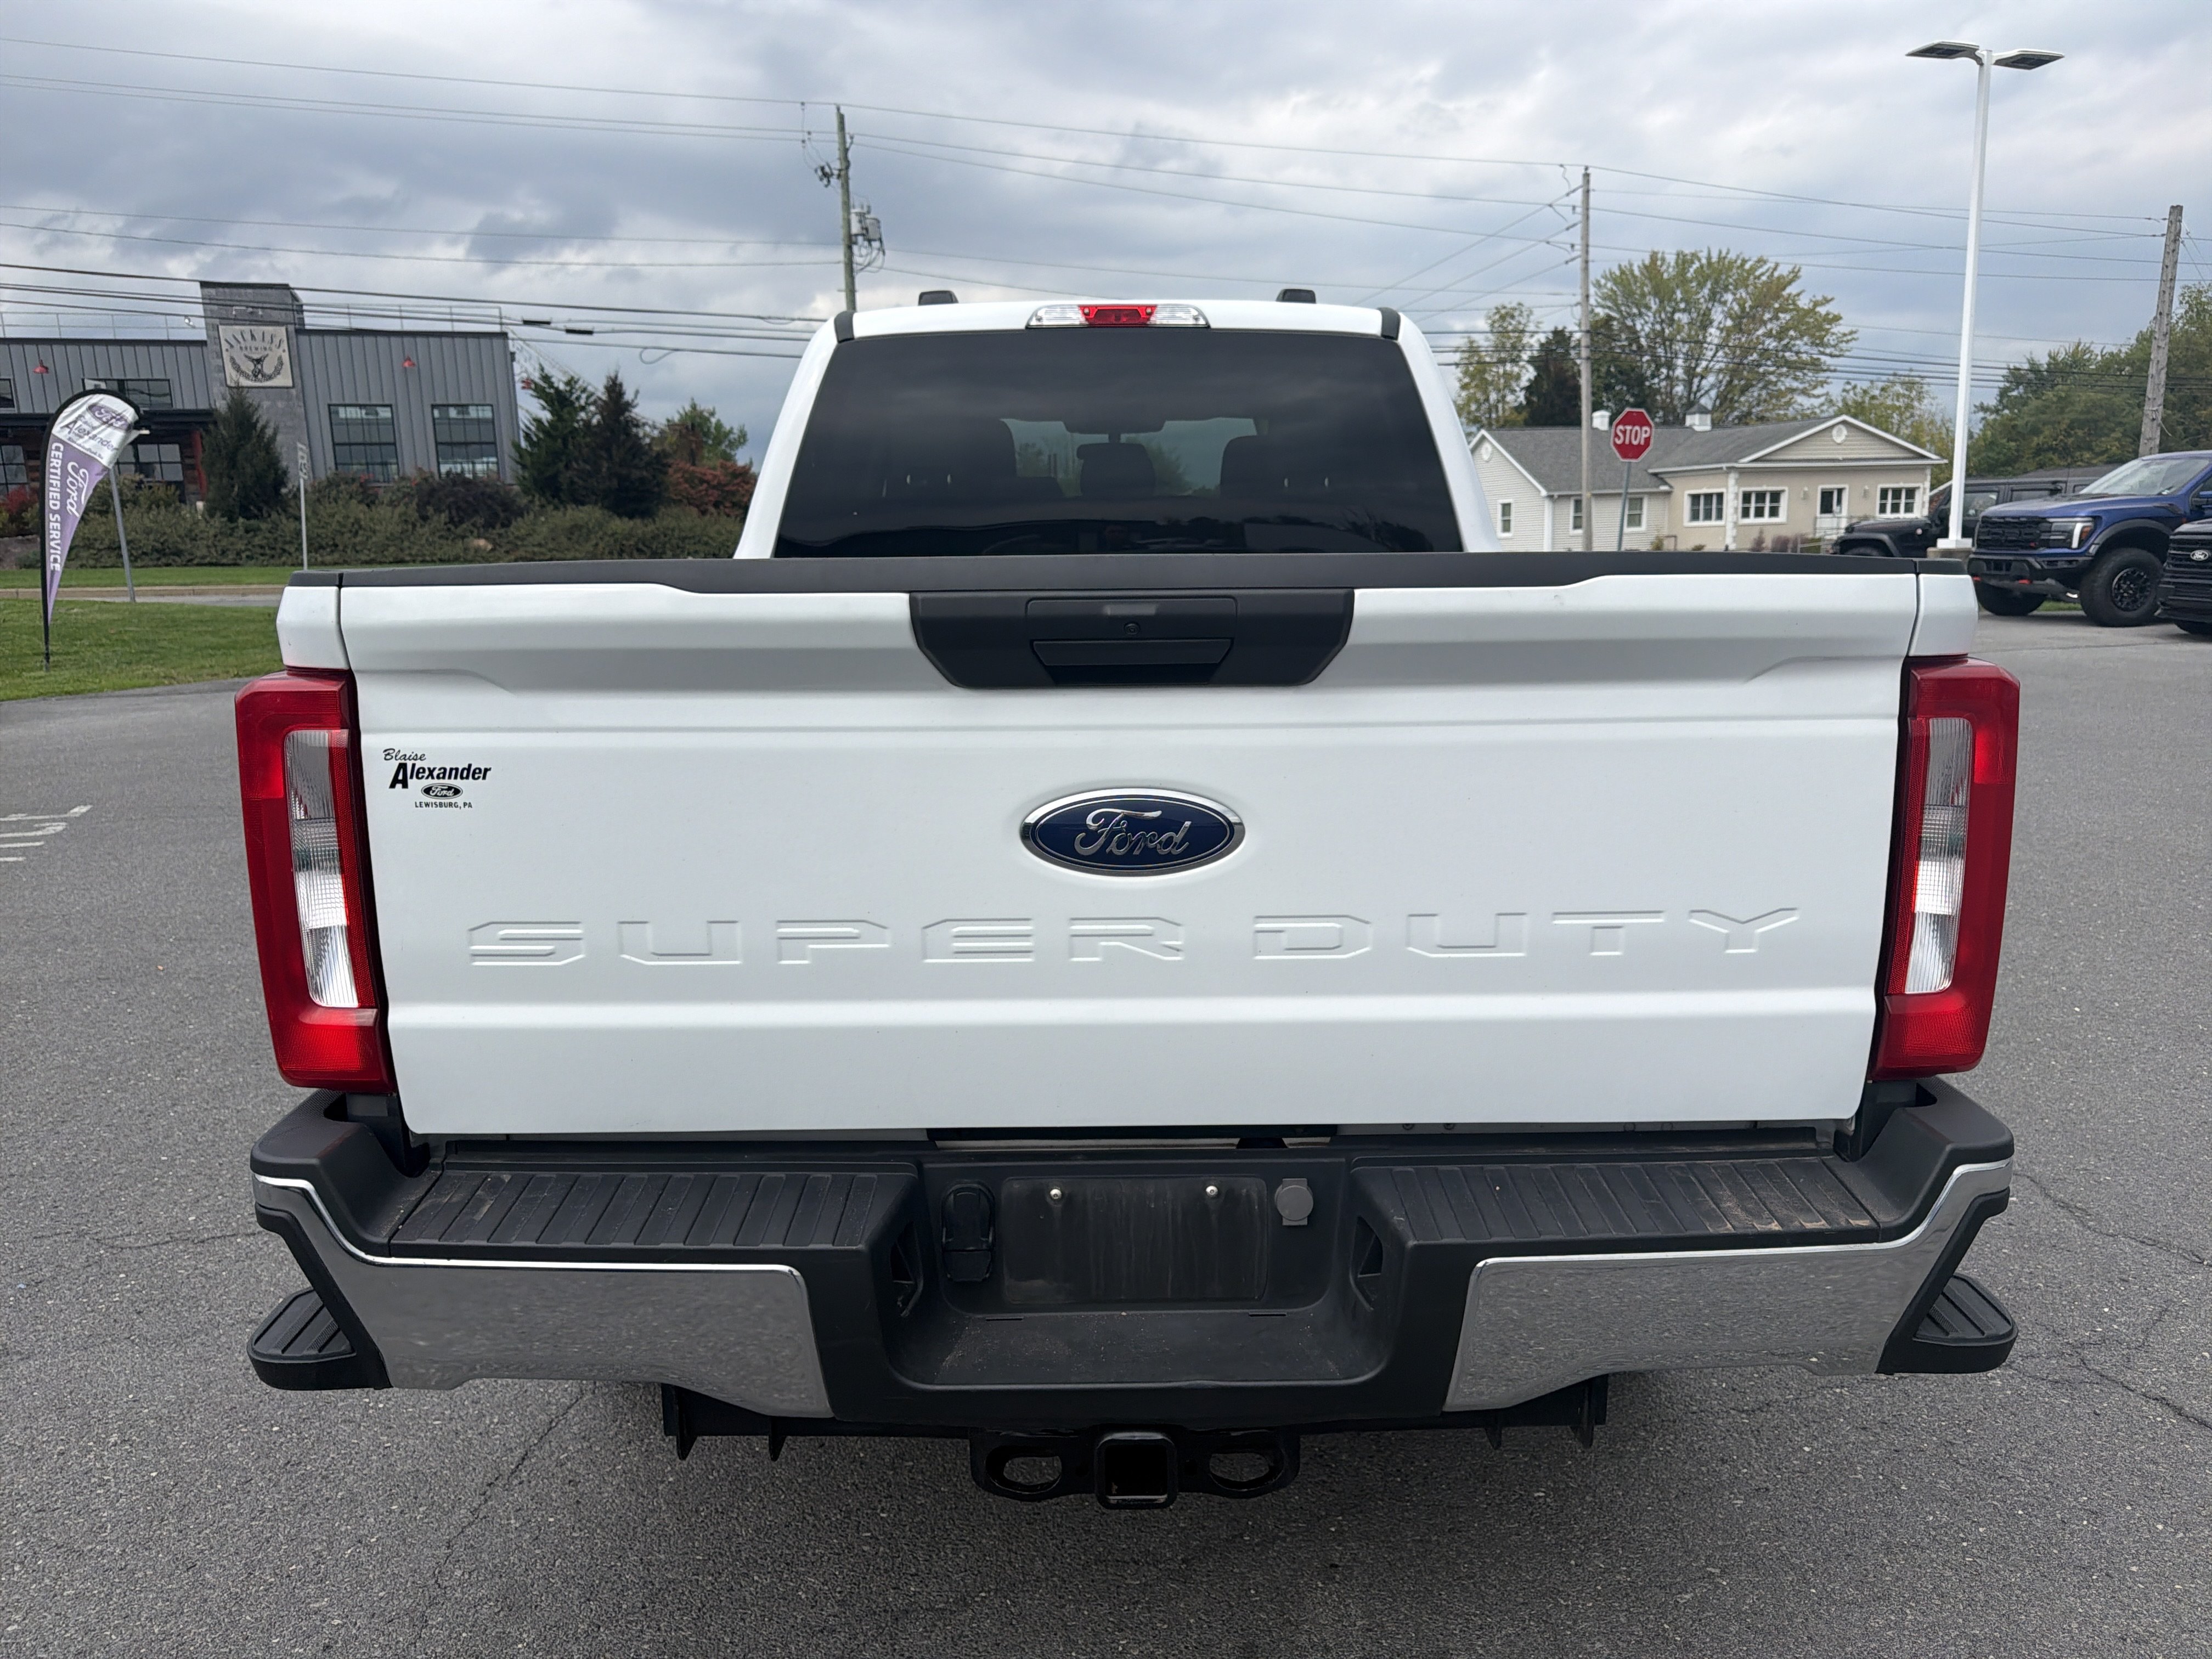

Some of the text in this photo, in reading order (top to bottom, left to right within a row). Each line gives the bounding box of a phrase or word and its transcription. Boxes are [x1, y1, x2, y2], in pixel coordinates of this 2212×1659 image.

[1614, 425, 1651, 445] STOP
[66, 461, 89, 518] Ford
[49, 443, 64, 571] CERTIFIED SERVICE
[382, 748, 426, 761] Blaise
[388, 762, 492, 789] Alexander
[430, 785, 455, 797] Ford
[414, 801, 462, 810] LEWISBURG,
[1074, 808, 1192, 856] Ford
[469, 907, 1800, 967] SUPER DUTY
